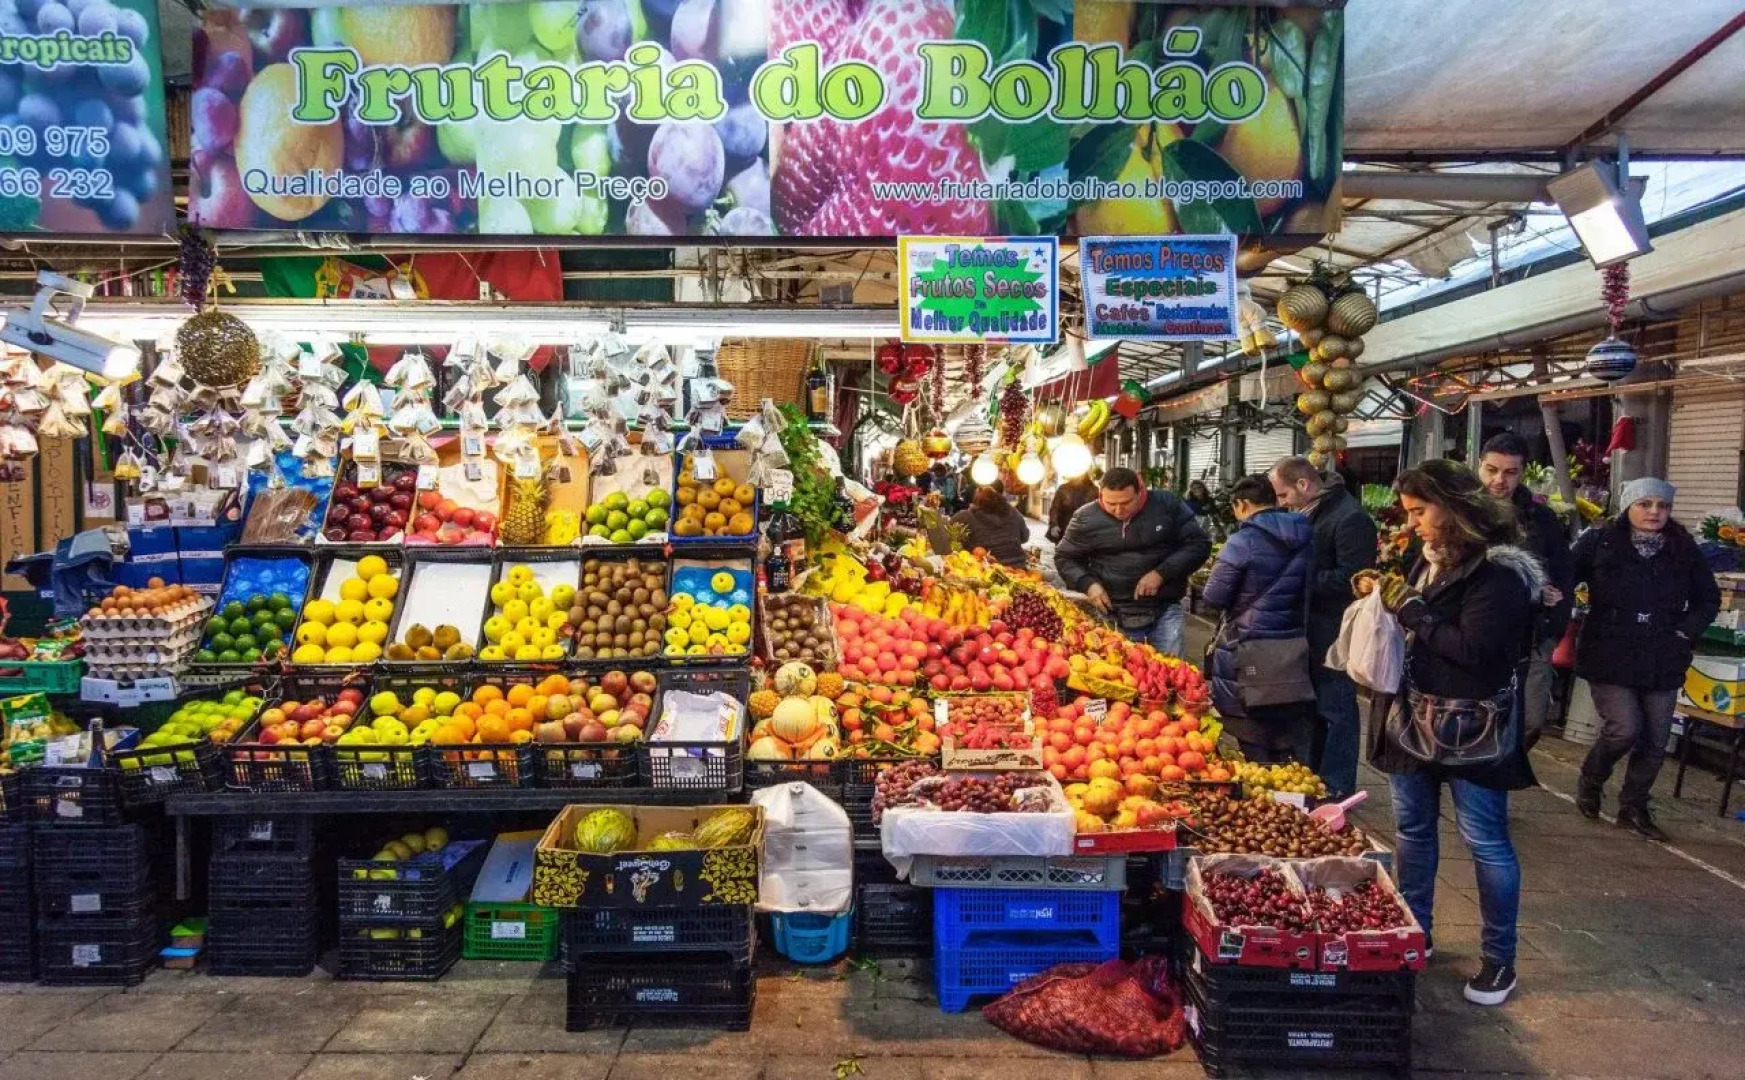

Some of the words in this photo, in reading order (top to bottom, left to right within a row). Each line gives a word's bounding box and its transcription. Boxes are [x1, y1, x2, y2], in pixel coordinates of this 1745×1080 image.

[0, 30, 135, 71] ropicais
[289, 44, 728, 124] Frutaria
[750, 40, 889, 124] do
[45, 126, 109, 157] 975
[50, 169, 115, 198] 232
[242, 168, 401, 197] Qualidade
[409, 175, 450, 198] ao
[458, 169, 566, 199] Melhor
[573, 170, 669, 206] Preço
[872, 177, 1304, 203] www.frutariadobolhao.blogspot.com
[945, 244, 1019, 267] Temos
[1091, 249, 1153, 274] Temos
[910, 275, 977, 298] Frutos
[983, 270, 1047, 299] Secos
[1105, 276, 1217, 301] Especiais
[911, 308, 965, 333] Melhor
[968, 310, 1047, 333] Qualidade
[1095, 303, 1150, 321] Cafés
